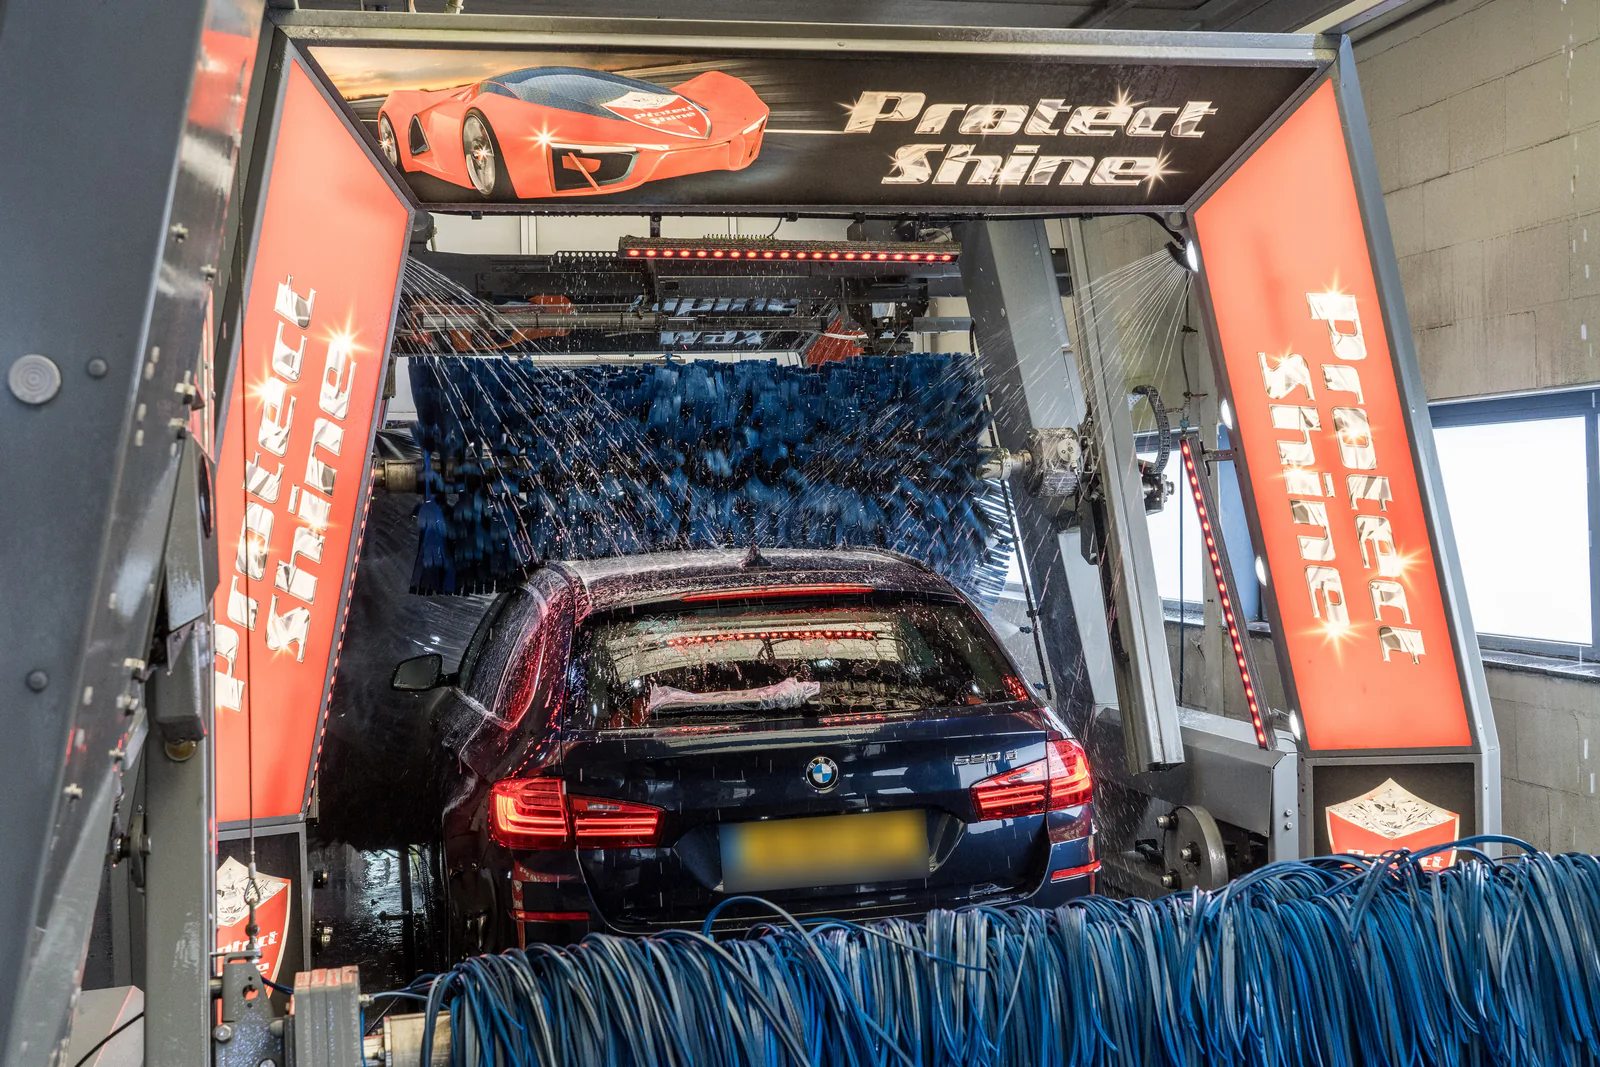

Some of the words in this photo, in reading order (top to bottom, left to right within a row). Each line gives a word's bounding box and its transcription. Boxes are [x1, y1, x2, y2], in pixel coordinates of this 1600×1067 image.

[844, 91, 1219, 138] Protect
[881, 143, 1164, 187] Shine
[214, 274, 316, 712] Protect
[266, 335, 357, 664] Shine
[1257, 351, 1351, 633] Shine
[1305, 292, 1427, 665] Protect
